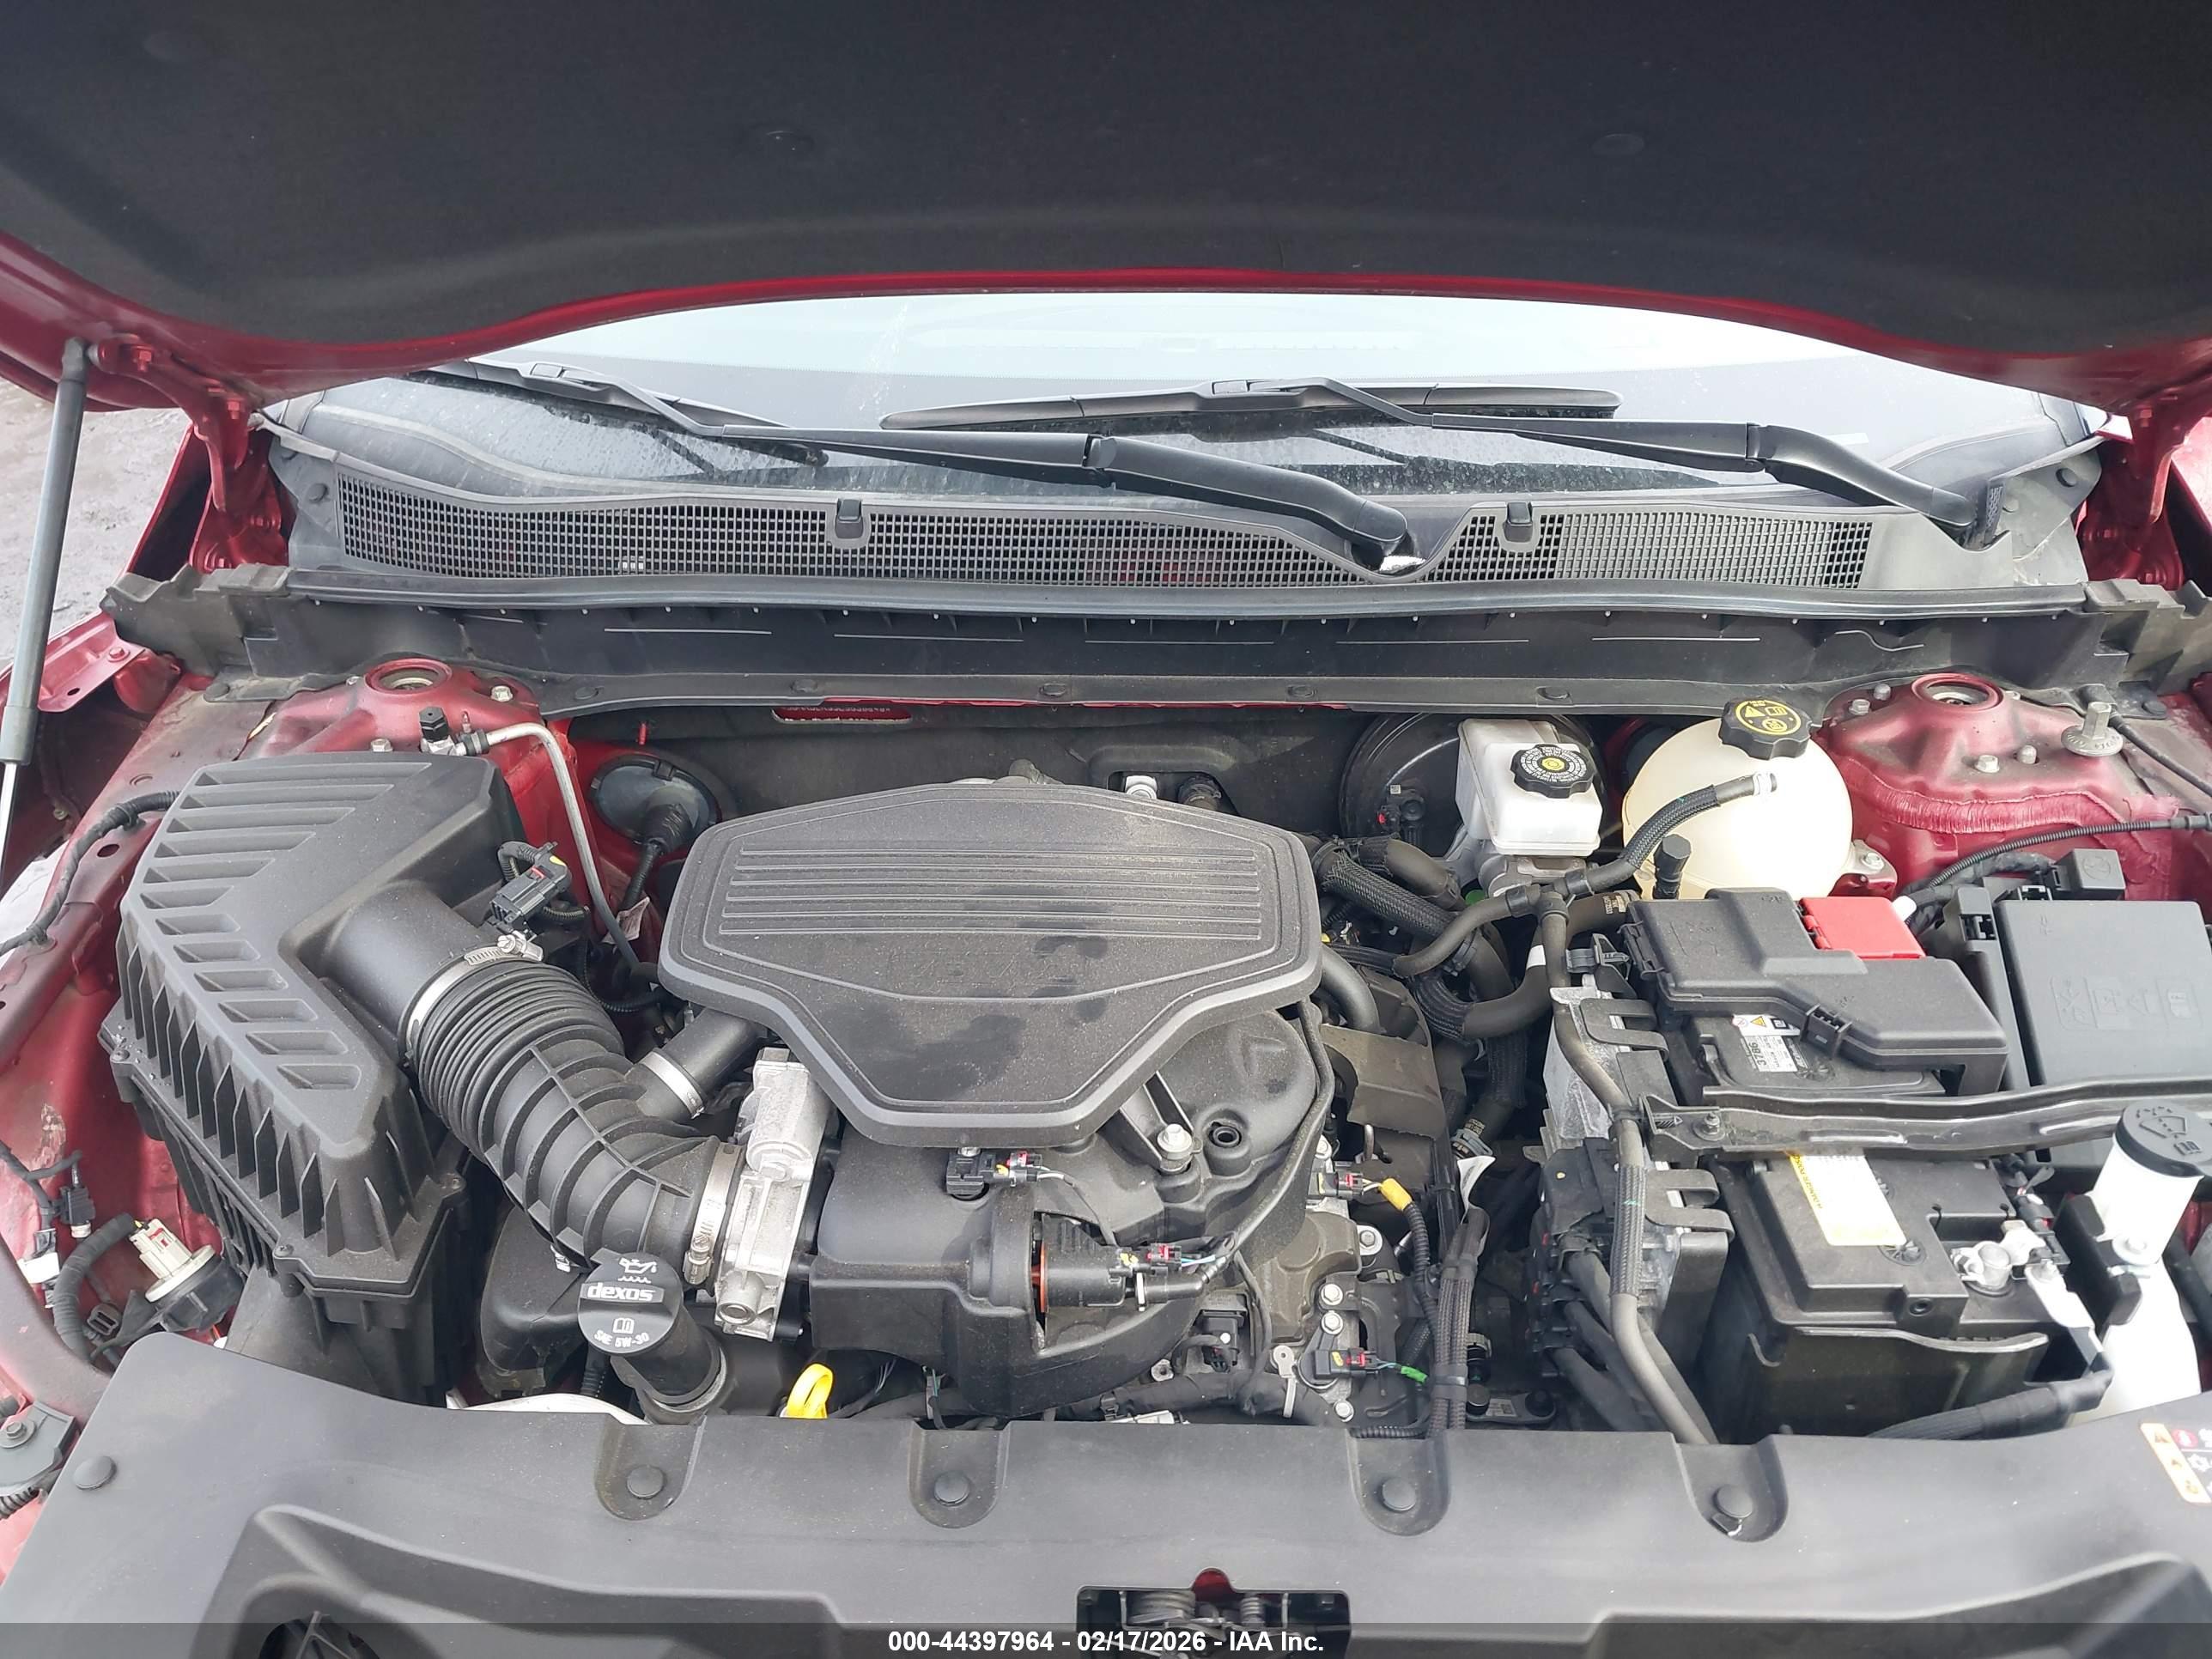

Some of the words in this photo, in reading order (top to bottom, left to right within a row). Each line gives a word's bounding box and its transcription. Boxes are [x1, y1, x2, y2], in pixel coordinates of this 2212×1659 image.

[586, 1282, 656, 1301] dexos
[594, 1330, 613, 1346] SAE
[615, 1333, 650, 1348] 5W-30
